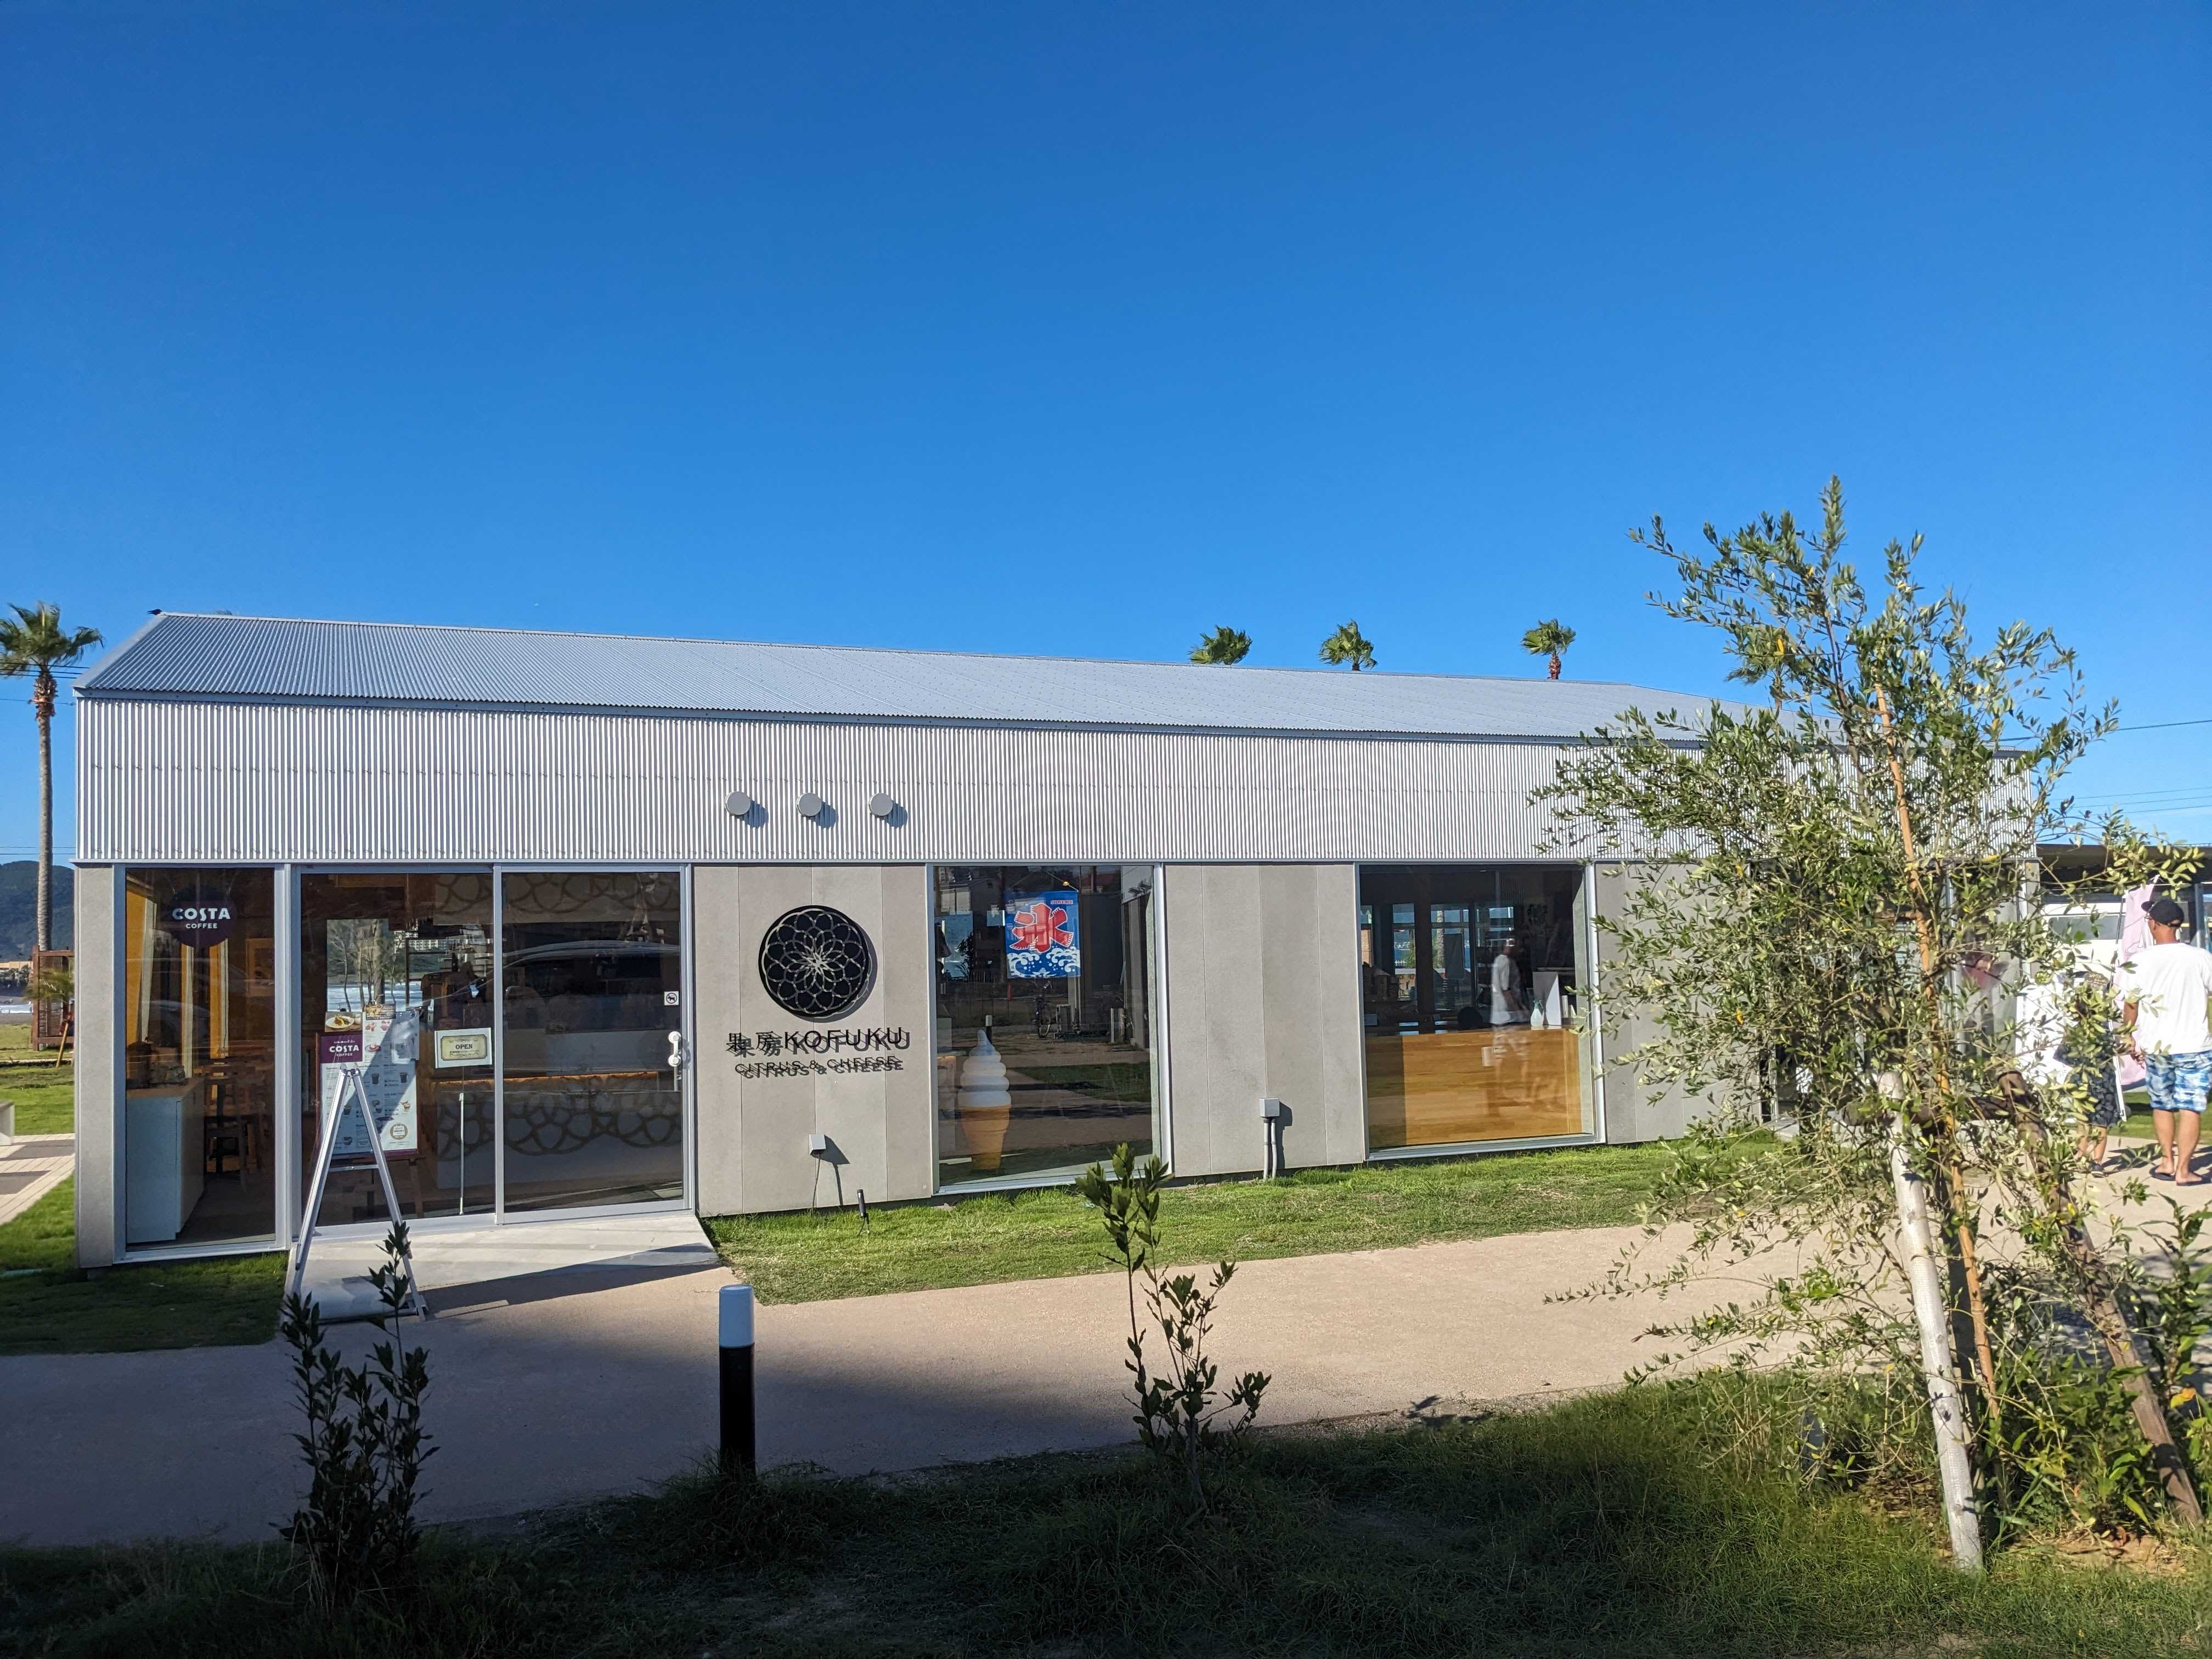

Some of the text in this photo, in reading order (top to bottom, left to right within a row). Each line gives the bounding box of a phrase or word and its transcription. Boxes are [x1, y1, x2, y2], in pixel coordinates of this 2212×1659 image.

[172, 907, 230, 922] COSTA
[1009, 902, 1074, 953] 氷
[784, 1027, 903, 1049] KOFUKU
[329, 1045, 360, 1053] COSTA
[735, 1060, 802, 1074] CITRUS
[827, 1056, 900, 1069] CHEESE
